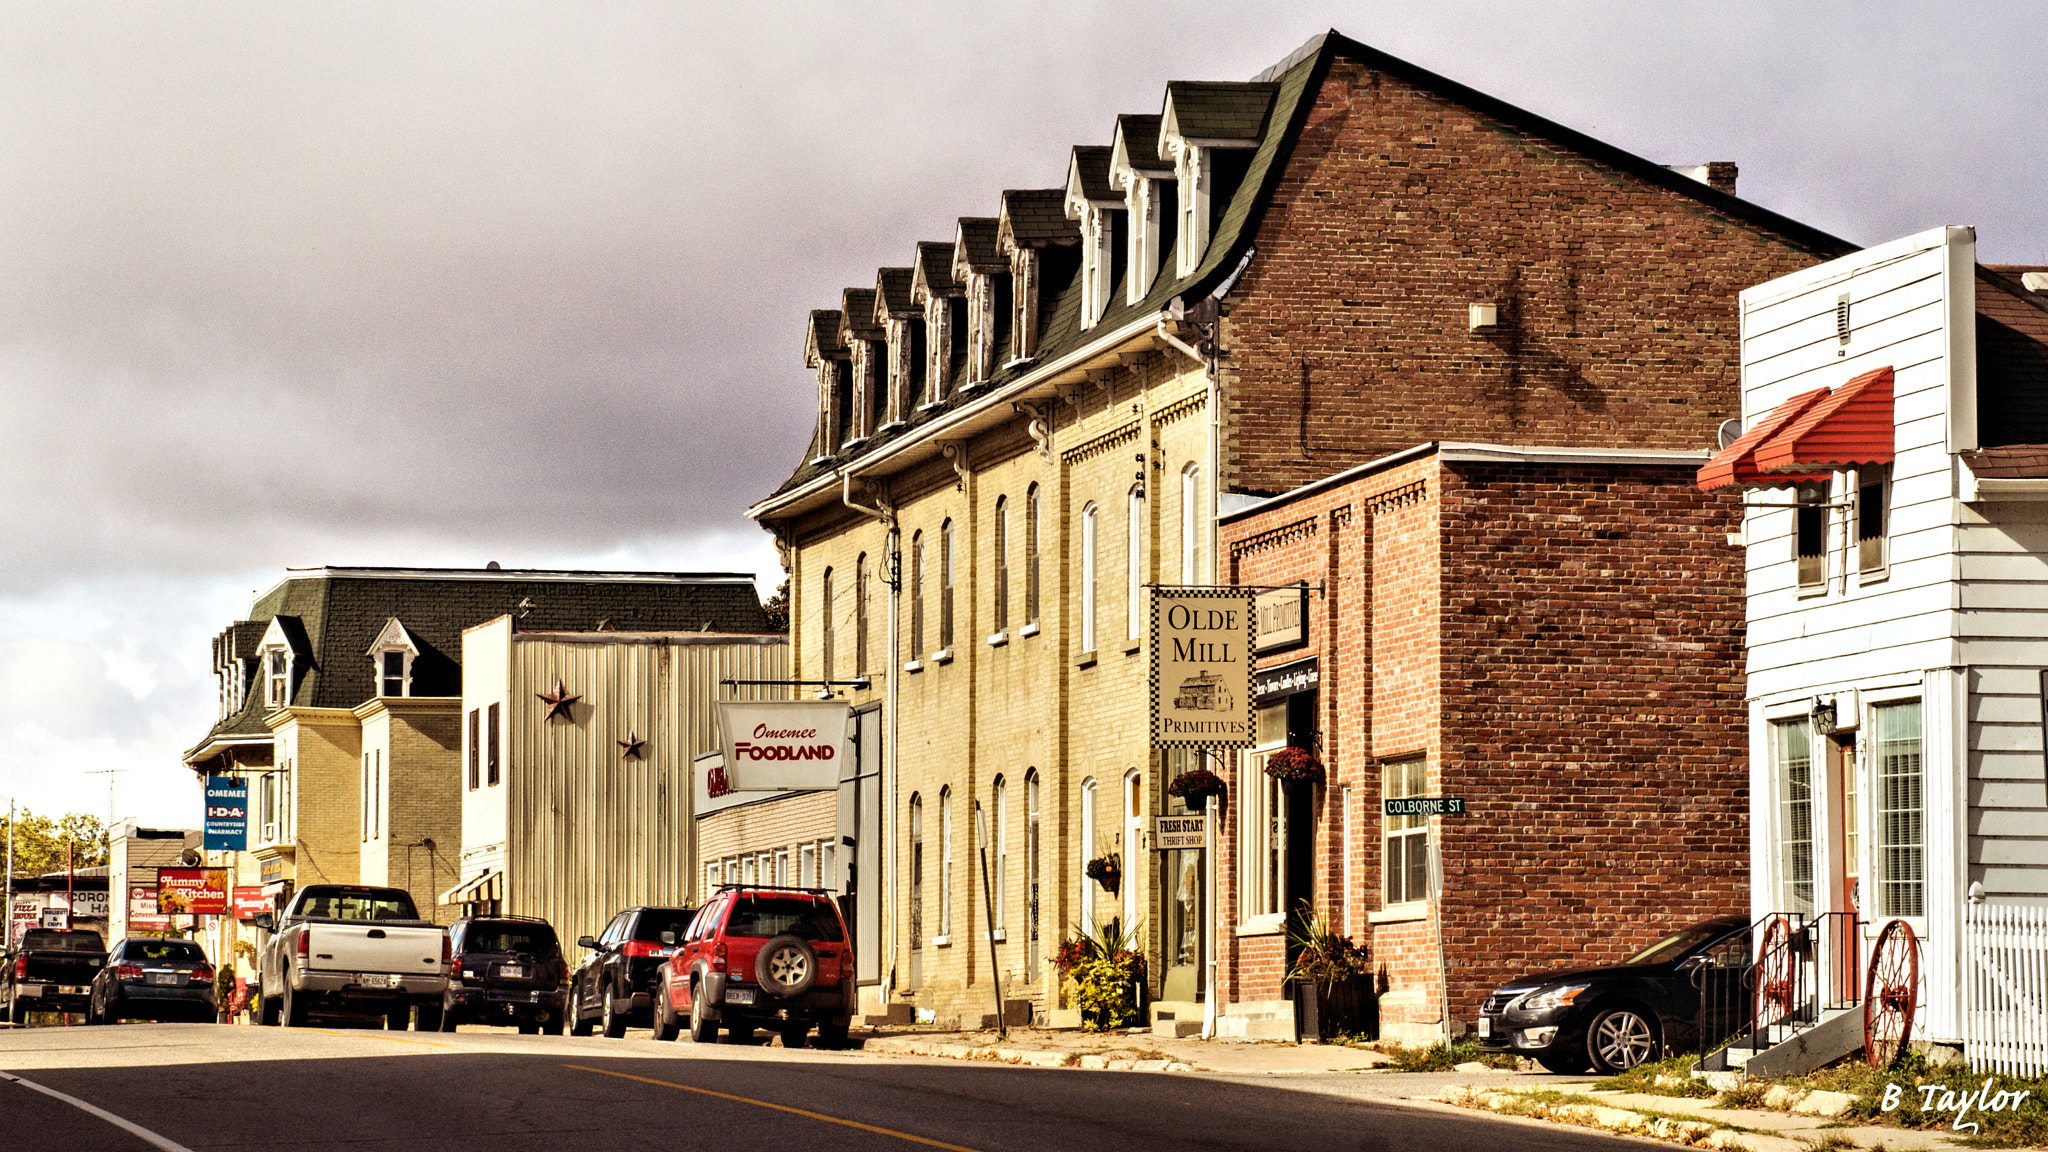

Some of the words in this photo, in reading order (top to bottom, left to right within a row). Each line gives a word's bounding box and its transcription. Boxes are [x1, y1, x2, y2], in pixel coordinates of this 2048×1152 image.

[1168, 604, 1239, 631] OLDE
[1172, 637, 1237, 663] MILL
[753, 723, 817, 739] Omemee
[1163, 717, 1245, 734] PRIMITIVES
[735, 742, 835, 761] FOODLAND
[207, 789, 246, 798] OMEMEE
[1387, 800, 1444, 813] COLBORNE
[1448, 799, 1461, 812] ST
[1160, 820, 1182, 833] FRESH
[1182, 819, 1204, 832] START
[1162, 836, 1185, 846] THRIFT
[1185, 835, 1203, 845] SHOP
[160, 876, 207, 889] Yummy
[177, 888, 225, 902] Kitchen
